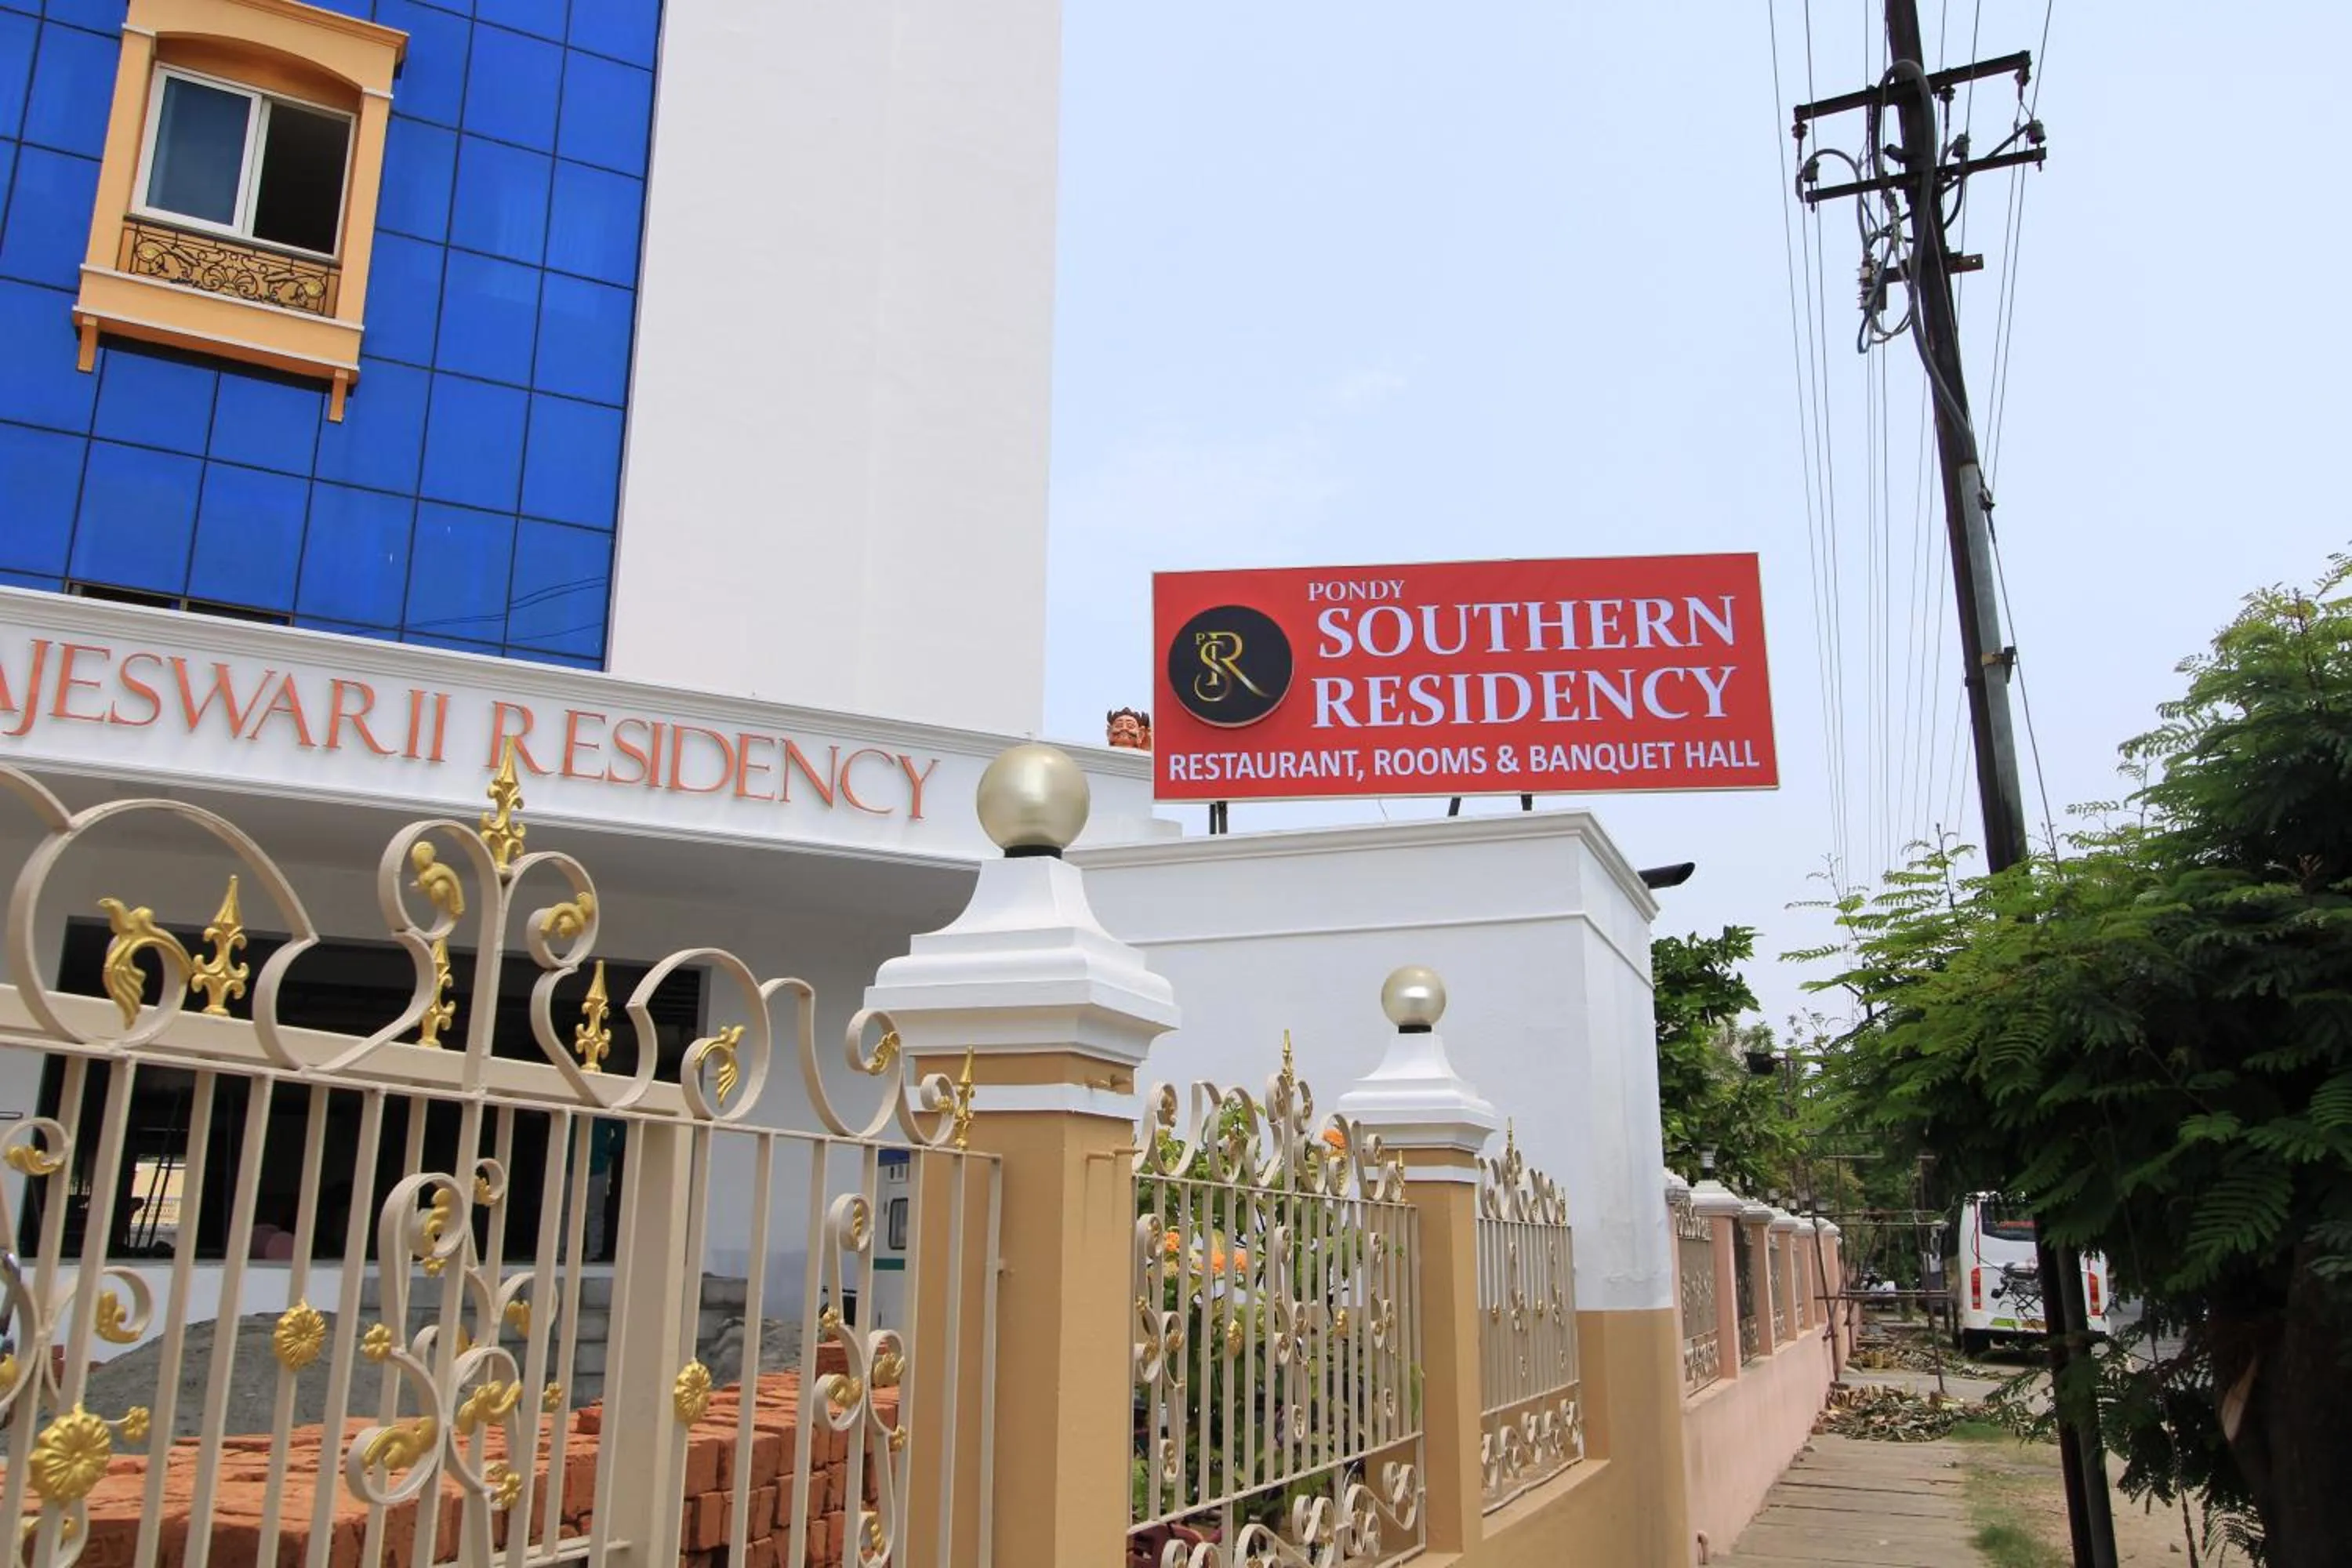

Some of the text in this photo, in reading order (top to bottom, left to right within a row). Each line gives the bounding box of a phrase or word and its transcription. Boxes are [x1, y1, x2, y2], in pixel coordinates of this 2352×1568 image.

[1308, 579, 1406, 602] PONDY
[1318, 594, 1737, 659] SOUTHERN
[1311, 665, 1737, 728] RESIDENCY
[0, 638, 941, 820] JESWARII RESIDENCY
[1169, 738, 1761, 782] RESTAURANT, ROOMS & BANQUET HALL
